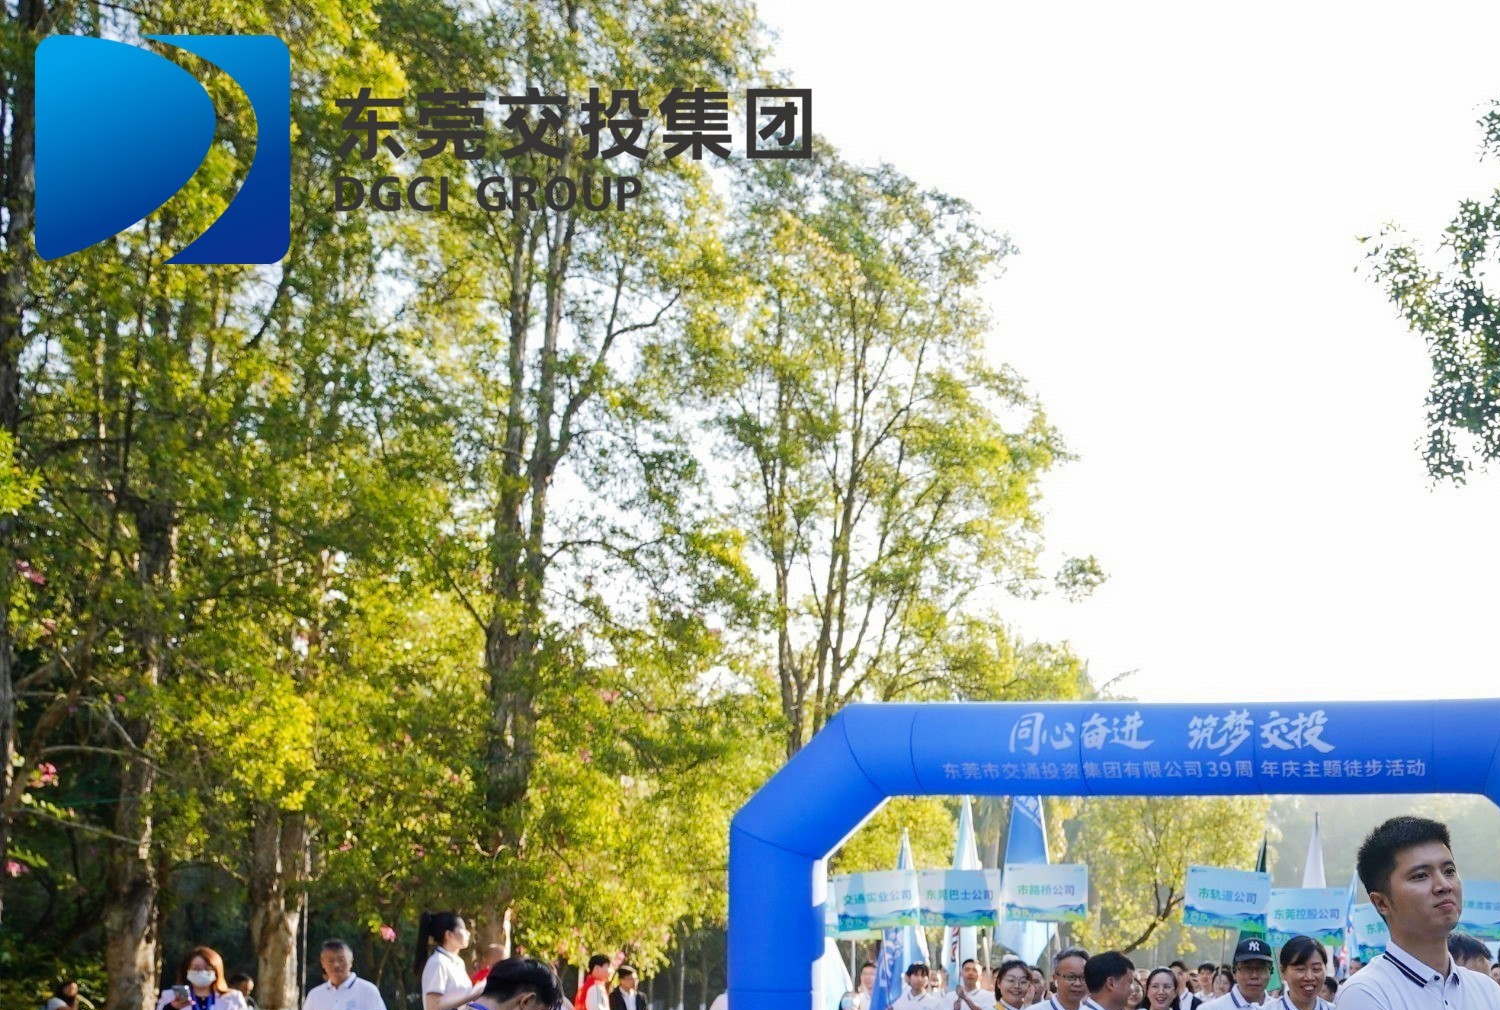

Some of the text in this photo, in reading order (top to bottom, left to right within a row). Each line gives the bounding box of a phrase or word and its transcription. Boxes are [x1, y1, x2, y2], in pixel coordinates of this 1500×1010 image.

[1009, 708, 1335, 757] 同心奋进 筑梦交投
[926, 888, 994, 901] 东莞巴士公司
[1017, 883, 1076, 896] 市路桥公司
[1198, 887, 1258, 905] 市轨道公司
[1273, 908, 1341, 921] 东莞控股公司
